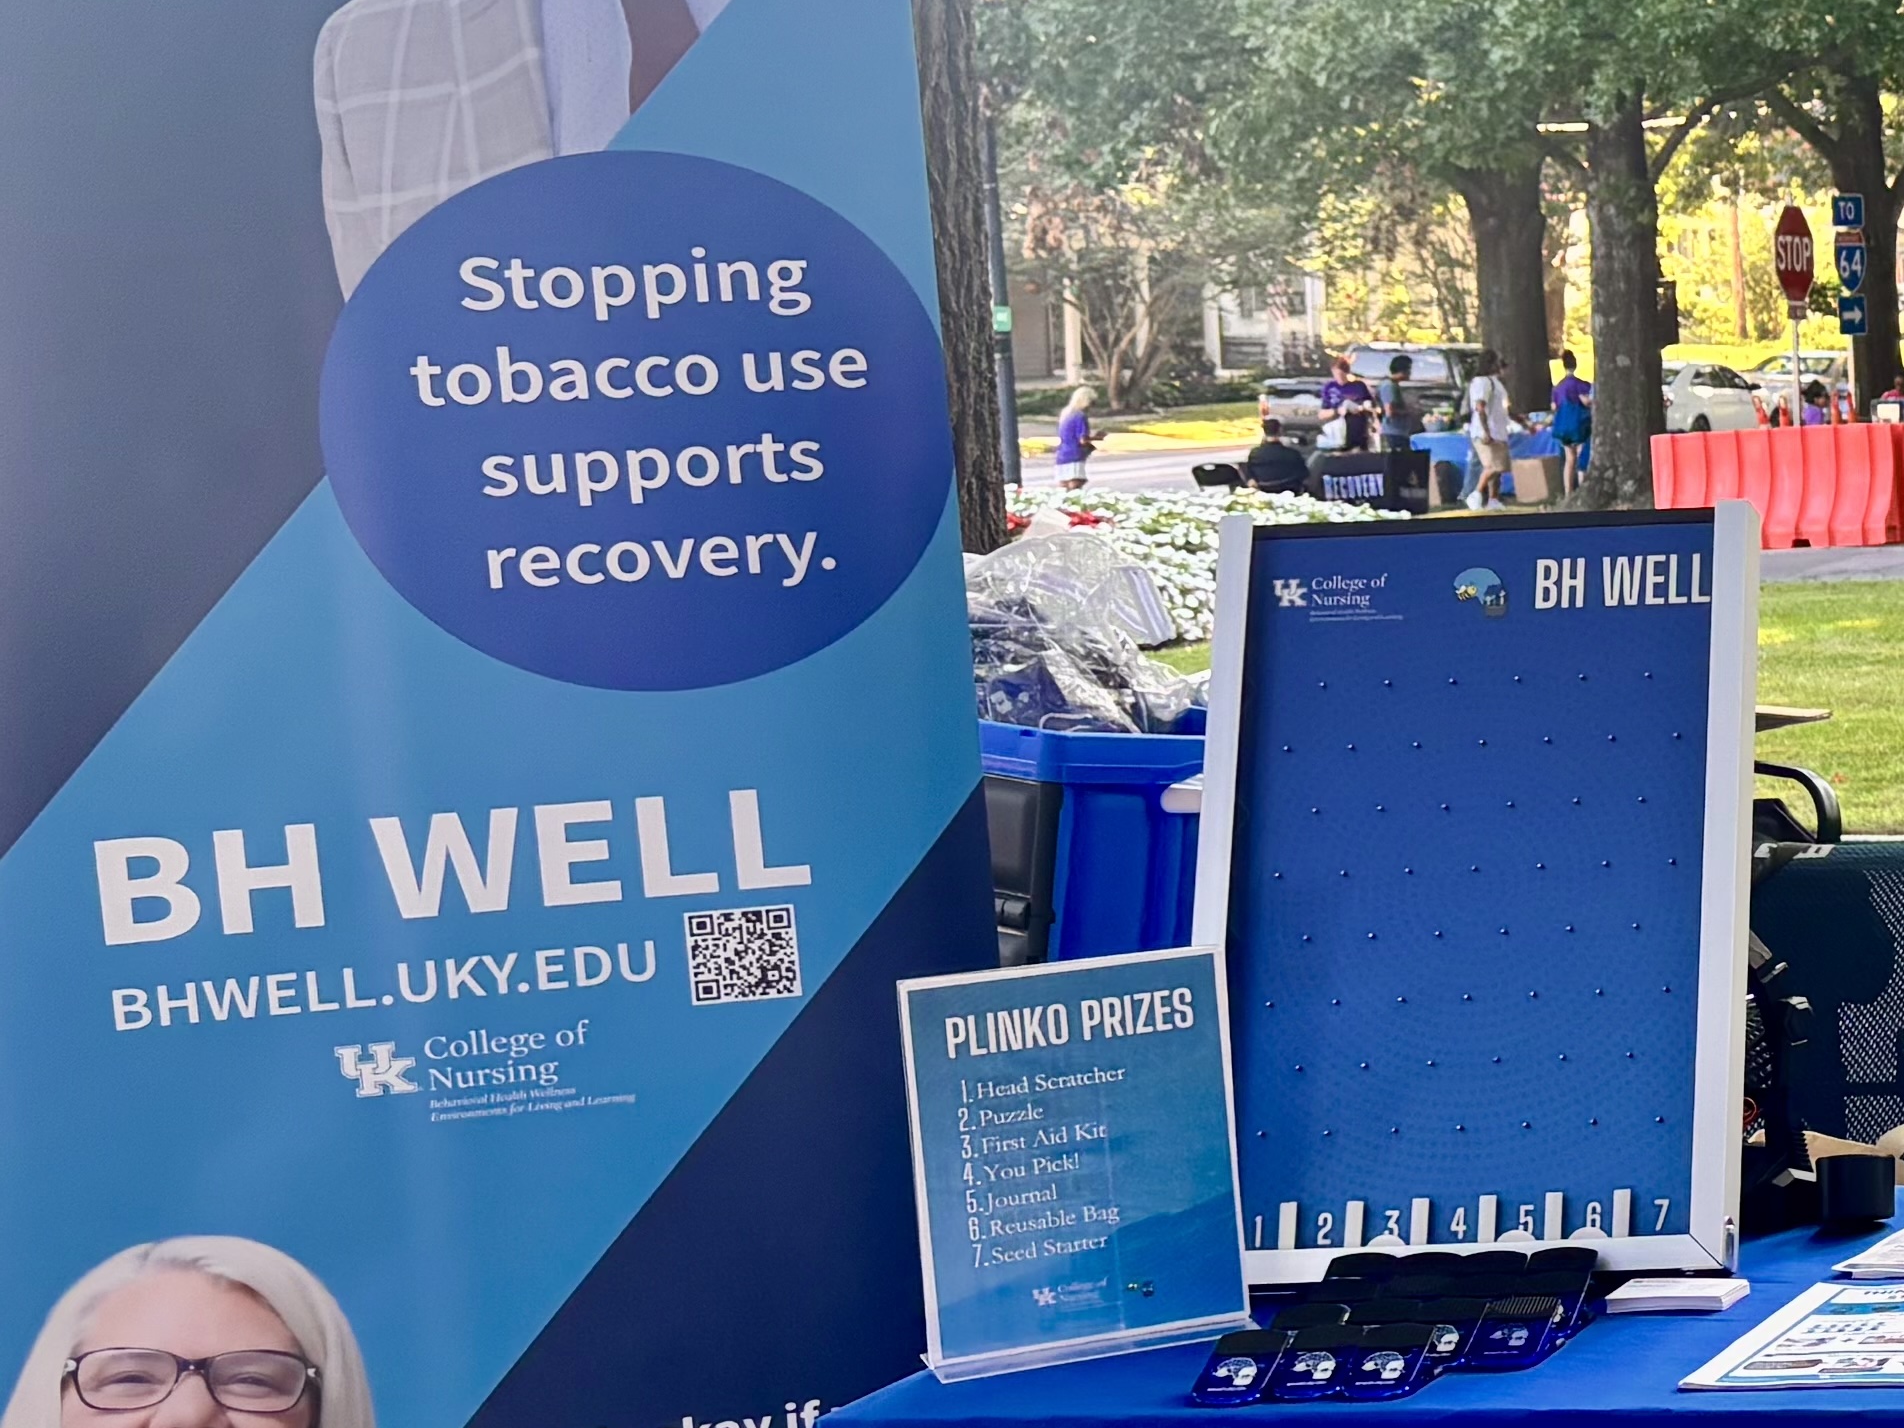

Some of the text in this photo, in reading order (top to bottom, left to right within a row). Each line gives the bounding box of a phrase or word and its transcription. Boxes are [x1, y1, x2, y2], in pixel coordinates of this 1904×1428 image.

[1839, 202, 1854, 220] TO
[1777, 236, 1811, 272] STOP
[1840, 250, 1861, 279] 64
[459, 245, 812, 321] Stopping
[410, 339, 868, 407] tobacco use
[481, 431, 825, 506] supports
[1322, 473, 1384, 500] RECOVERY
[486, 530, 837, 590] recovery.
[1311, 573, 1387, 591] College of
[1535, 552, 1713, 609] BH WELL
[1311, 591, 1370, 607] Nursing
[93, 788, 812, 949] BH WELL
[111, 938, 659, 1033] BHWELL.UKY.EDU
[424, 1020, 589, 1059] College of
[945, 987, 1194, 1059] PLINKO PRIZES
[428, 1061, 559, 1091] Nursing
[977, 1075, 1029, 1100] Head
[1035, 1066, 1126, 1092] Scratcher
[958, 1103, 1044, 1132] 2. Puzzle
[960, 1121, 1107, 1159] 3. First Aid Kit
[963, 1153, 1079, 1186] 4. You Pick!
[966, 1184, 1057, 1215] 5. Journal
[968, 1204, 1120, 1241] 6. Reusable Bag
[1254, 1216, 1262, 1247] 1
[1317, 1213, 1332, 1245] 2
[1451, 1207, 1466, 1238] 4
[1519, 1204, 1534, 1234] 5
[1587, 1201, 1601, 1231] 6
[1654, 1199, 1670, 1231] 7
[971, 1235, 1109, 1268] 7. Seed Starter
